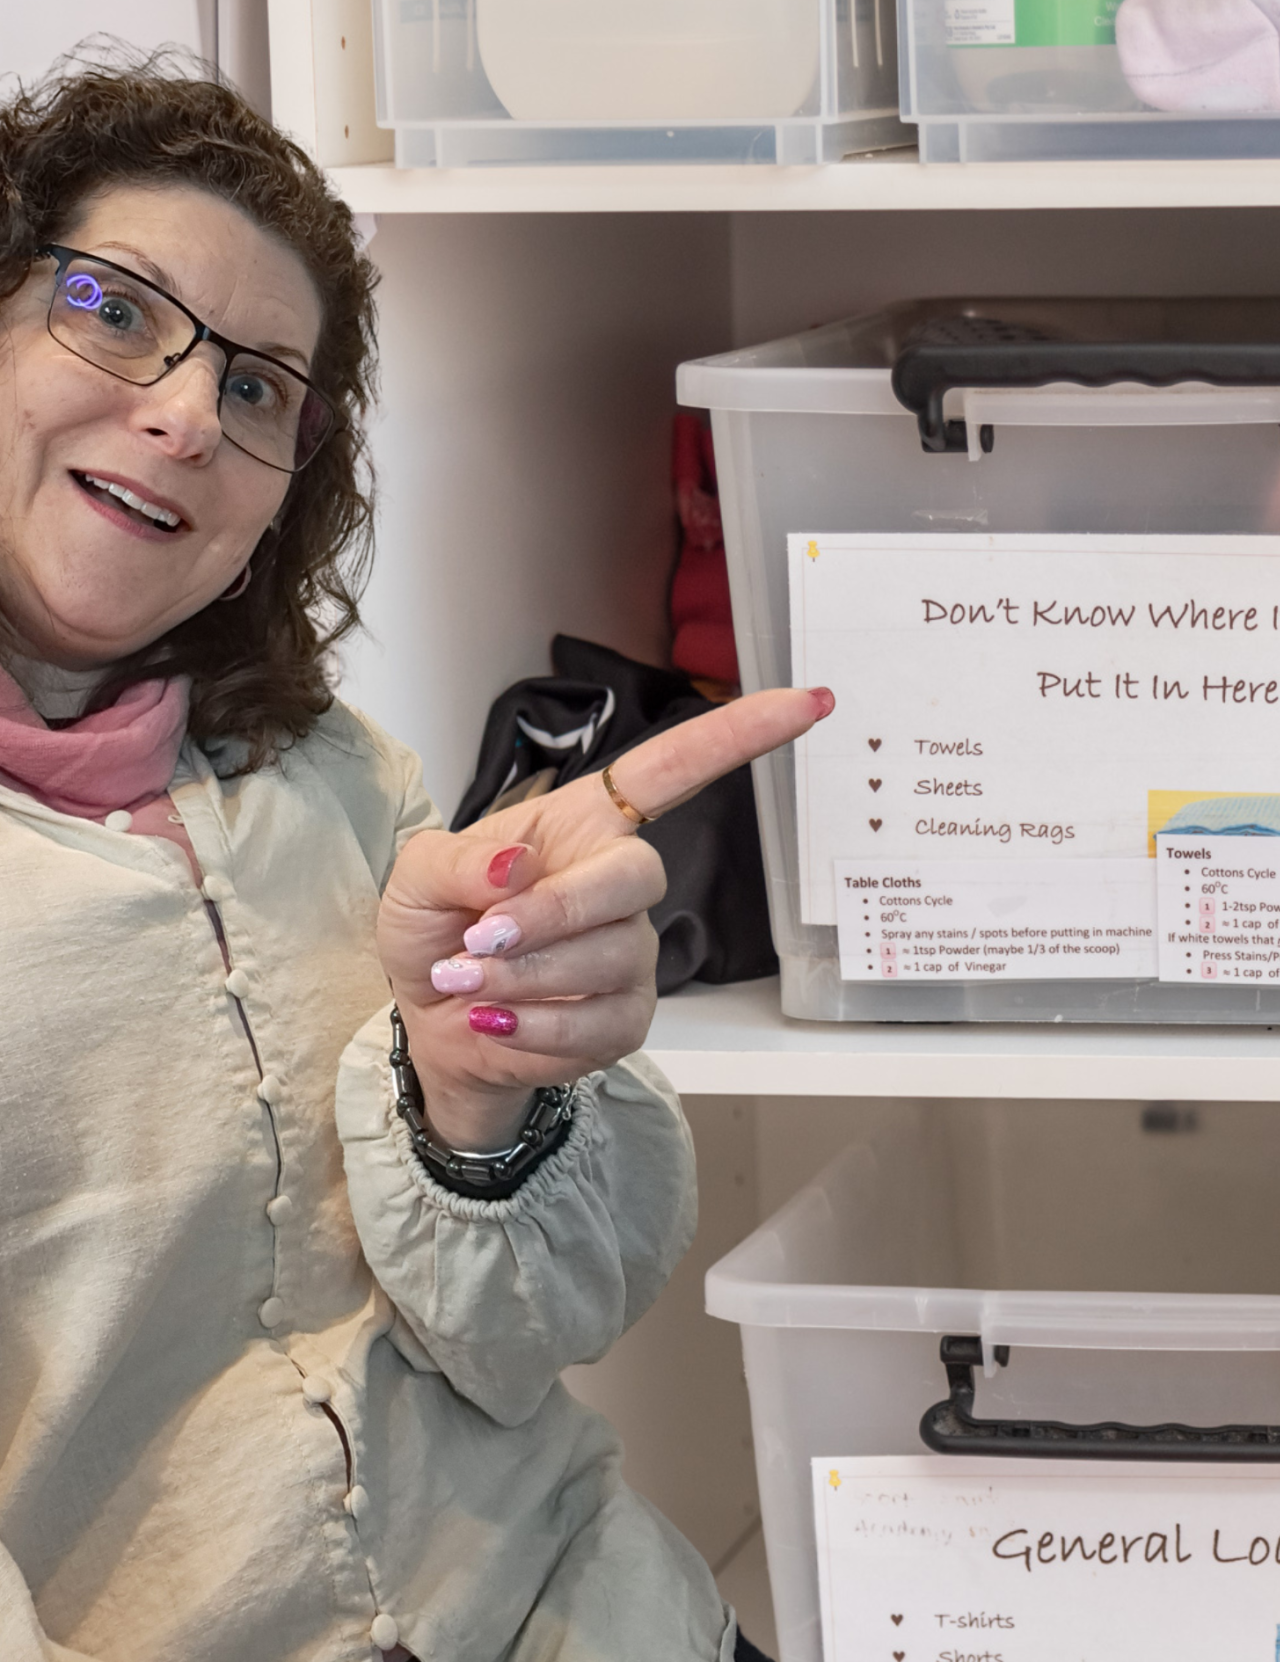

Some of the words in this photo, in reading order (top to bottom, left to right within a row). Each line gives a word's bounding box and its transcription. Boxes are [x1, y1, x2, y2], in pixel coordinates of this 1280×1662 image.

[921, 597, 1020, 625] Don't
[1033, 600, 1136, 628] Know
[1148, 598, 1258, 632] Where
[1036, 671, 1102, 699] Put
[1115, 672, 1139, 699] It
[1152, 674, 1190, 700] In
[914, 737, 984, 757] Towels
[913, 777, 984, 797] Sheets
[914, 817, 1012, 844] Cleaning
[1018, 822, 1076, 845] Rags
[1166, 847, 1212, 860] Towels
[1200, 866, 1245, 878] Cottons
[1246, 867, 1277, 881] Cycle
[844, 876, 879, 889] Table
[882, 876, 922, 889] Cloths
[878, 895, 922, 906] Cottons
[923, 895, 954, 908] Cycle
[1222, 900, 1257, 914] 1-2tsp
[1241, 920, 1262, 931] cap
[1267, 918, 1280, 930] of
[881, 928, 912, 941] Spray
[914, 930, 935, 941] any
[936, 928, 969, 939] stains
[979, 928, 1009, 940] spots
[1011, 926, 1048, 938] before
[1050, 927, 1091, 940] putting
[1092, 927, 1103, 937] in
[1105, 926, 1153, 937] machine
[1168, 932, 1176, 943] If
[1178, 932, 1210, 944] white
[1212, 934, 1250, 945] towels
[1251, 934, 1275, 946] that
[913, 945, 937, 957] 1tsp
[938, 944, 981, 955] Powder
[983, 944, 1025, 957] (maybe
[1027, 943, 1046, 956] 1/3
[1048, 943, 1060, 955] of
[1062, 943, 1082, 954] the
[1083, 943, 1121, 956] scoop)
[1202, 949, 1232, 961] Press
[922, 963, 943, 974] cap
[947, 961, 960, 972] of
[964, 961, 1007, 974] Vinegar
[1242, 969, 1263, 980] cap
[1268, 967, 1280, 979] of
[992, 1522, 1192, 1573] General
[934, 1611, 1016, 1629] T-shirts
